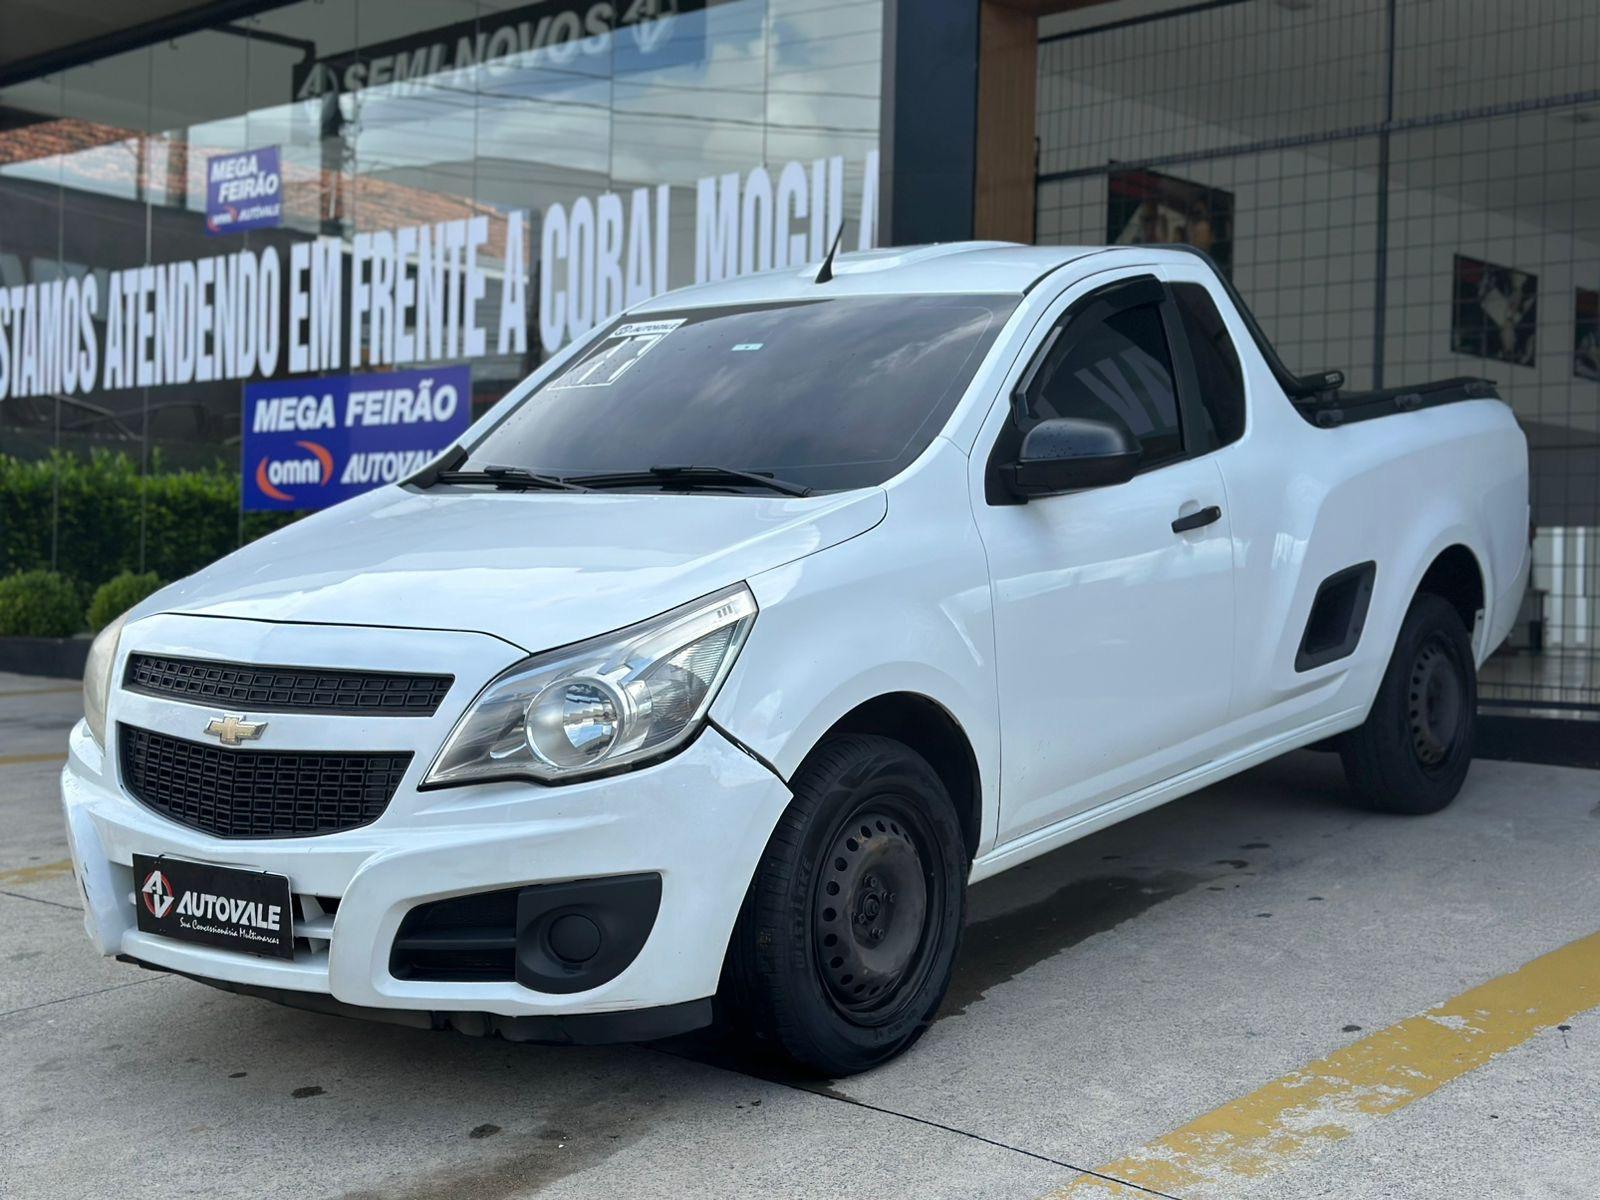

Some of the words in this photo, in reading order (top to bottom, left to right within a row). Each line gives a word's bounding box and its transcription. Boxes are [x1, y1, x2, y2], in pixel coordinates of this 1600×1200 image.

[343, 7, 614, 98] SEMI-NOVOS
[210, 154, 258, 184] MEGA
[218, 170, 279, 204] FEIRÃO
[103, 246, 281, 390] ATENDENDO
[288, 238, 342, 374] EM
[350, 216, 489, 367] FRENTE
[497, 210, 528, 355] A
[252, 394, 336, 433] MEGA
[345, 379, 457, 427] FEIRÃO
[268, 459, 320, 485] omni
[340, 449, 445, 485] AUTOVA
[176, 890, 281, 931] AUTOVALE
[239, 927, 280, 945] Multimarcas
